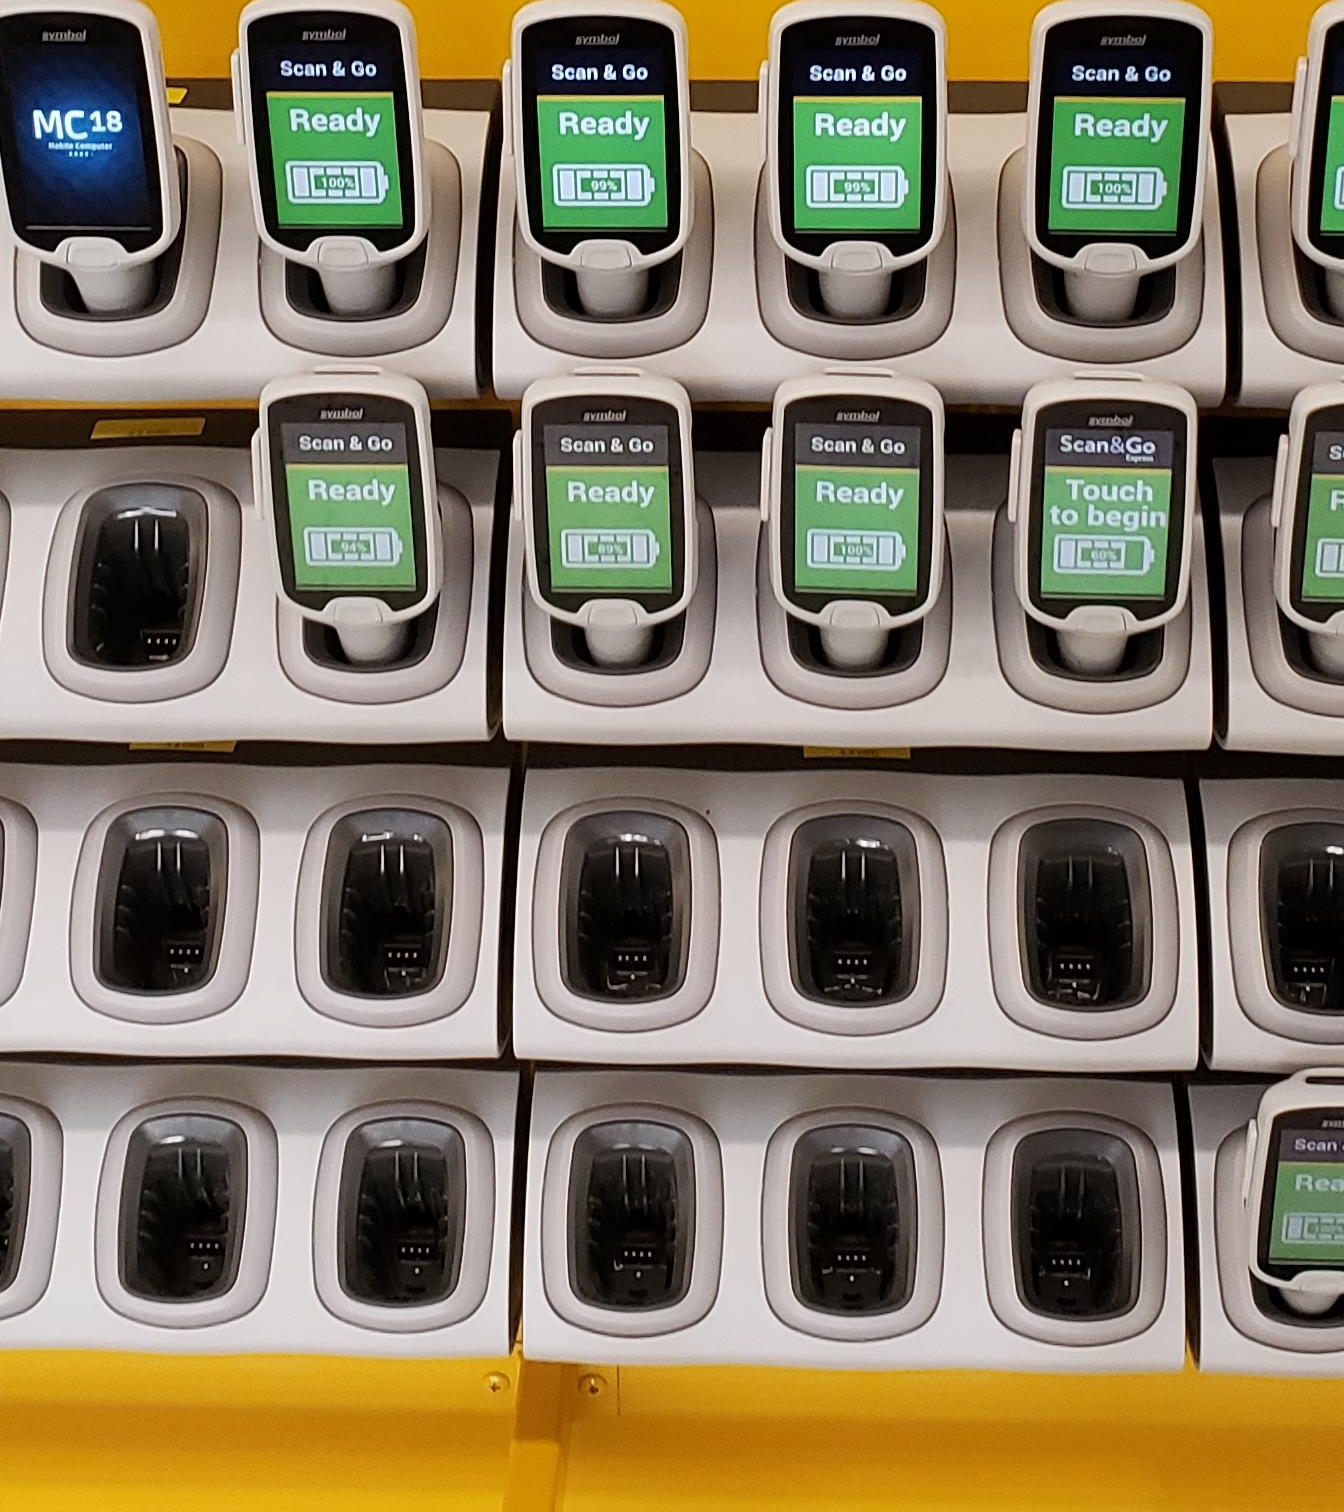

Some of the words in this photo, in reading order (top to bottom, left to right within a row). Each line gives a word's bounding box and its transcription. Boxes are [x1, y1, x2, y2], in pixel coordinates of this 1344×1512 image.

[280, 60, 327, 76] Scan
[333, 61, 345, 76] &
[351, 61, 377, 76] Go
[552, 64, 598, 80] Scan
[604, 64, 616, 80] &
[623, 64, 648, 80] Go
[810, 65, 856, 81] Scan
[862, 65, 875, 81] &
[881, 65, 907, 81] Go
[1072, 65, 1120, 81] Scan
[1125, 66, 1139, 82] &
[1145, 66, 1171, 82] Go
[289, 107, 380, 137] Ready
[558, 111, 650, 140] Ready
[815, 112, 907, 142] Ready
[1074, 113, 1168, 142] Ready
[75, 142, 112, 150] Computer
[299, 436, 344, 451] Scan
[350, 436, 362, 451] &
[368, 436, 392, 451] Go
[561, 438, 605, 452] Scan
[611, 438, 623, 452] &
[629, 438, 653, 452] Go
[811, 437, 856, 452] Scan
[862, 439, 874, 453] &
[880, 439, 905, 454] Go
[308, 479, 395, 505] Ready
[567, 481, 654, 507] Ready
[816, 481, 904, 509] Ready
[1066, 479, 1153, 502] Touch
[1049, 505, 1079, 525] to
[1088, 504, 1166, 531] begin
